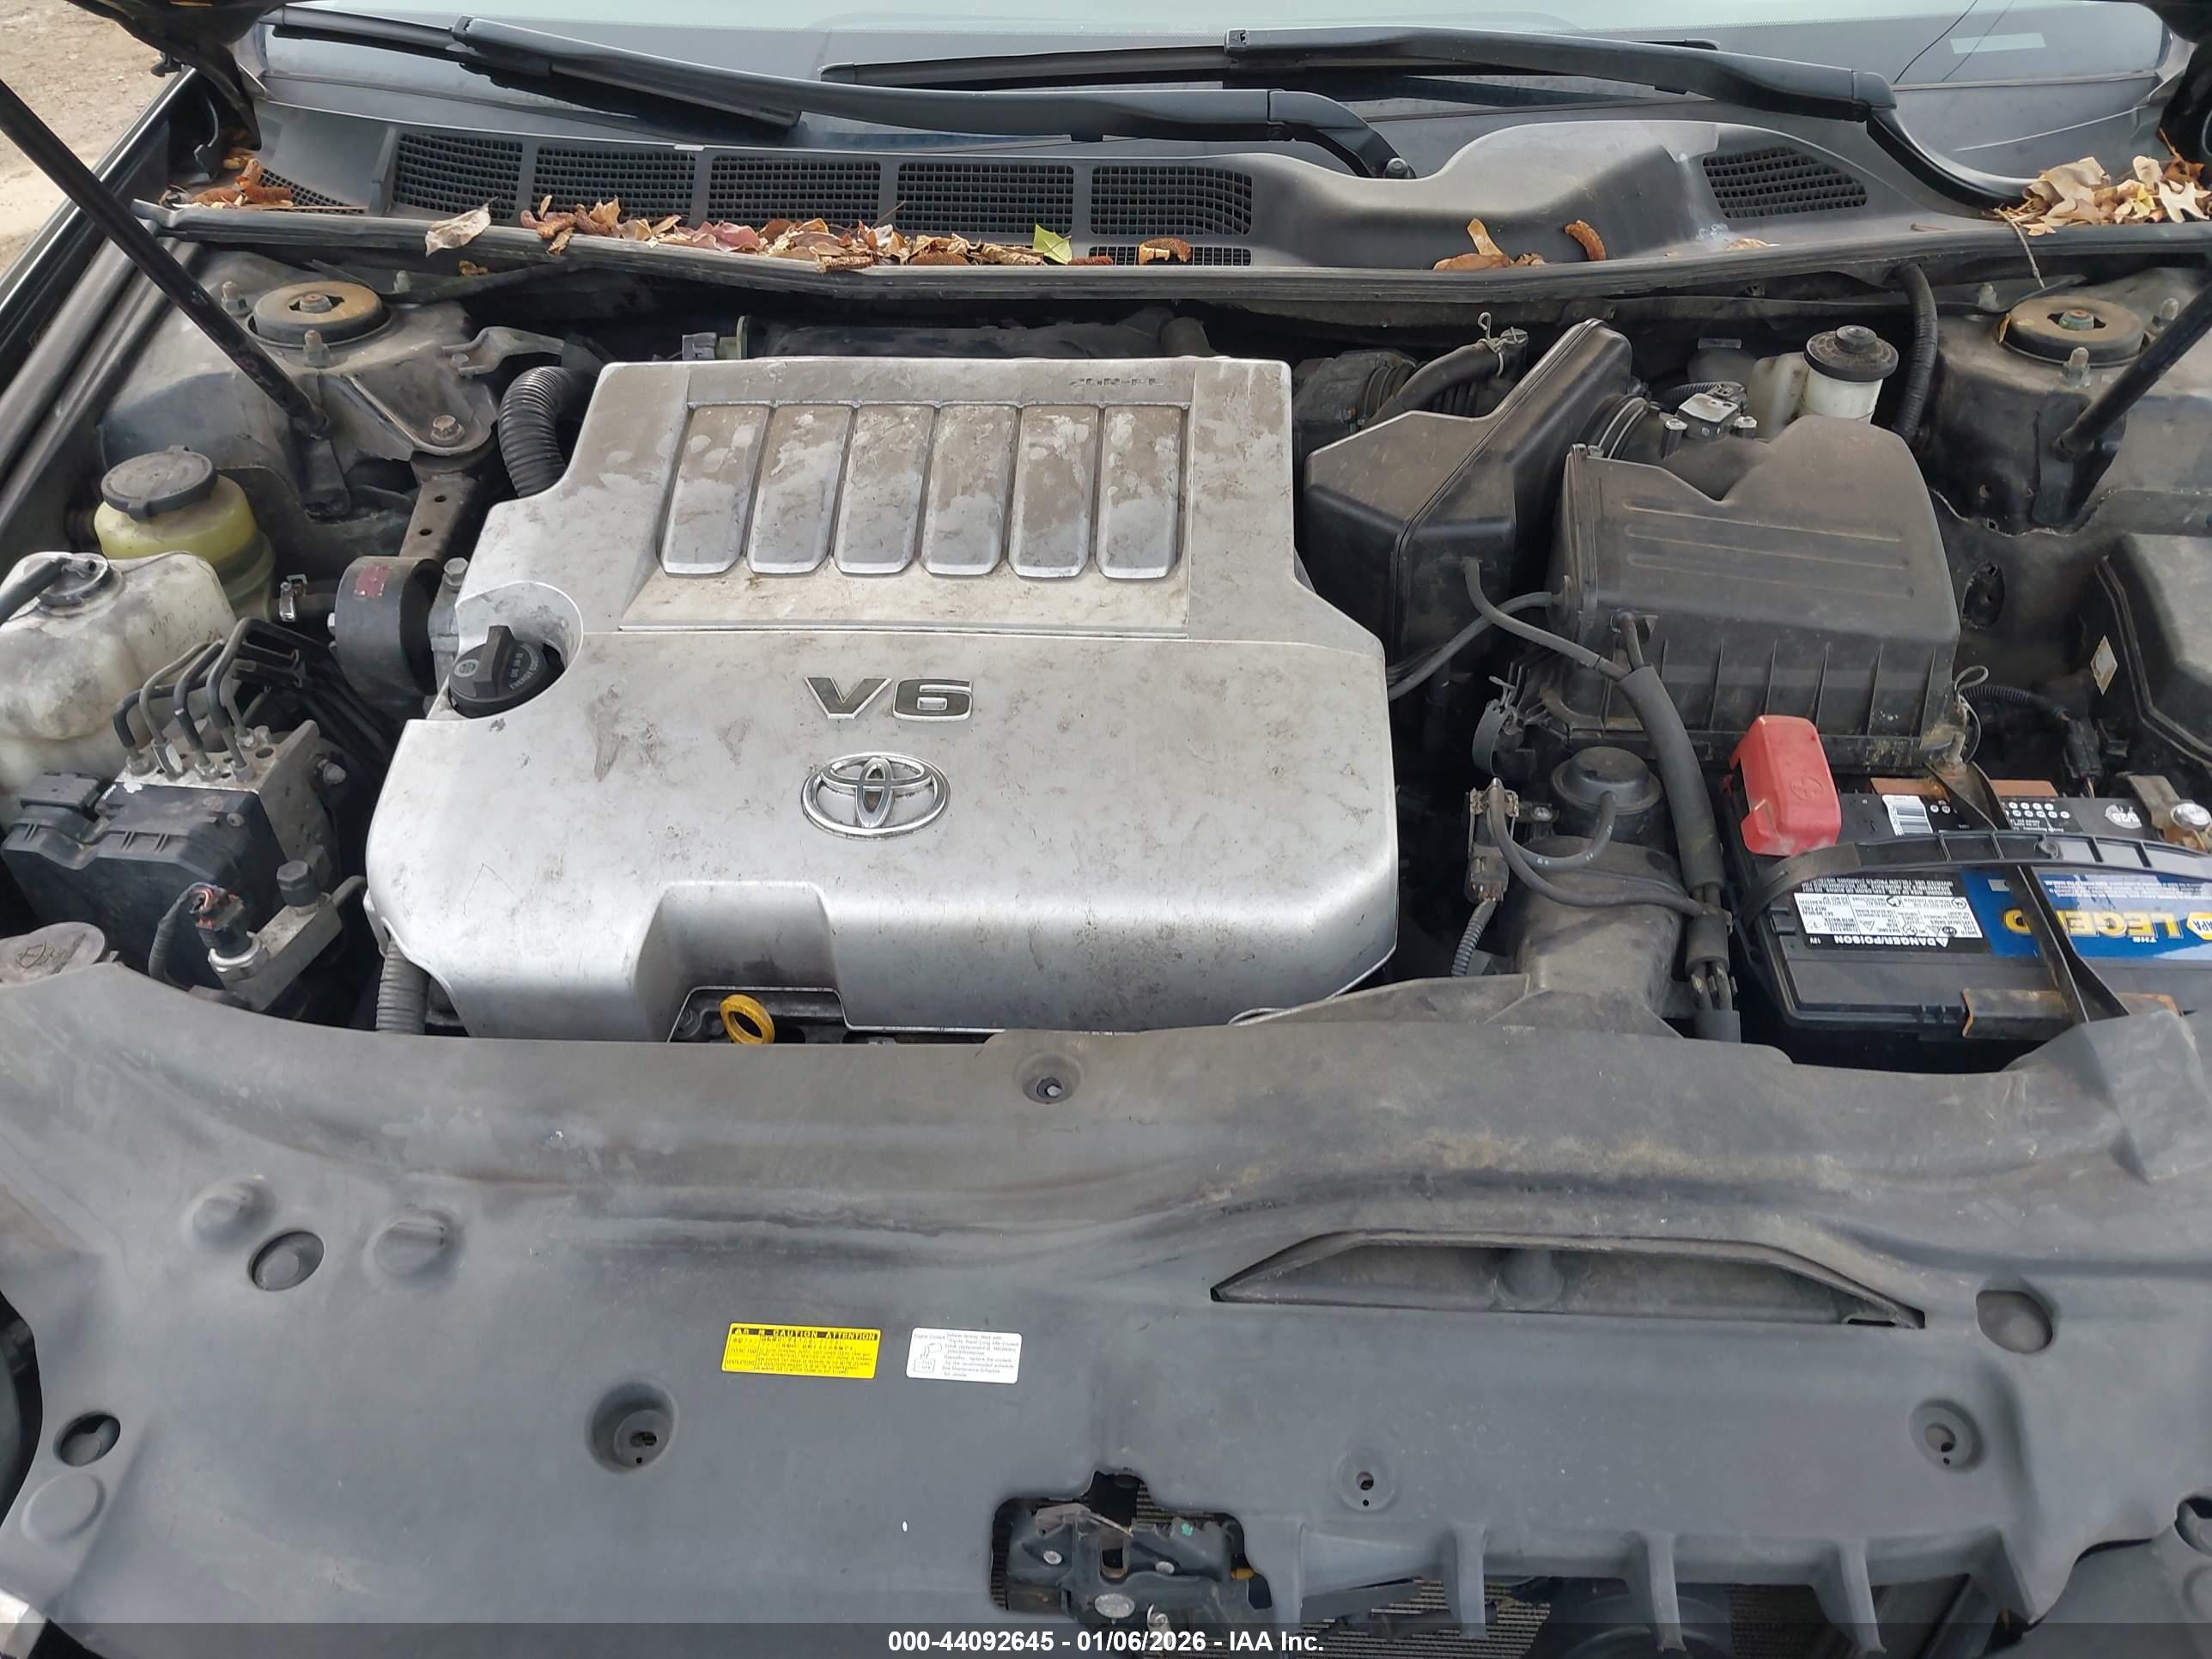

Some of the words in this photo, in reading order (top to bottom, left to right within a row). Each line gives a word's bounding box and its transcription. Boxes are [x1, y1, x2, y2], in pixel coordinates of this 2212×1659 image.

[803, 676, 973, 722] V6
[1833, 935, 1937, 947] DANGER/POISON
[773, 1329, 818, 1339] CAUTION
[825, 1331, 876, 1340] ATTENTION
